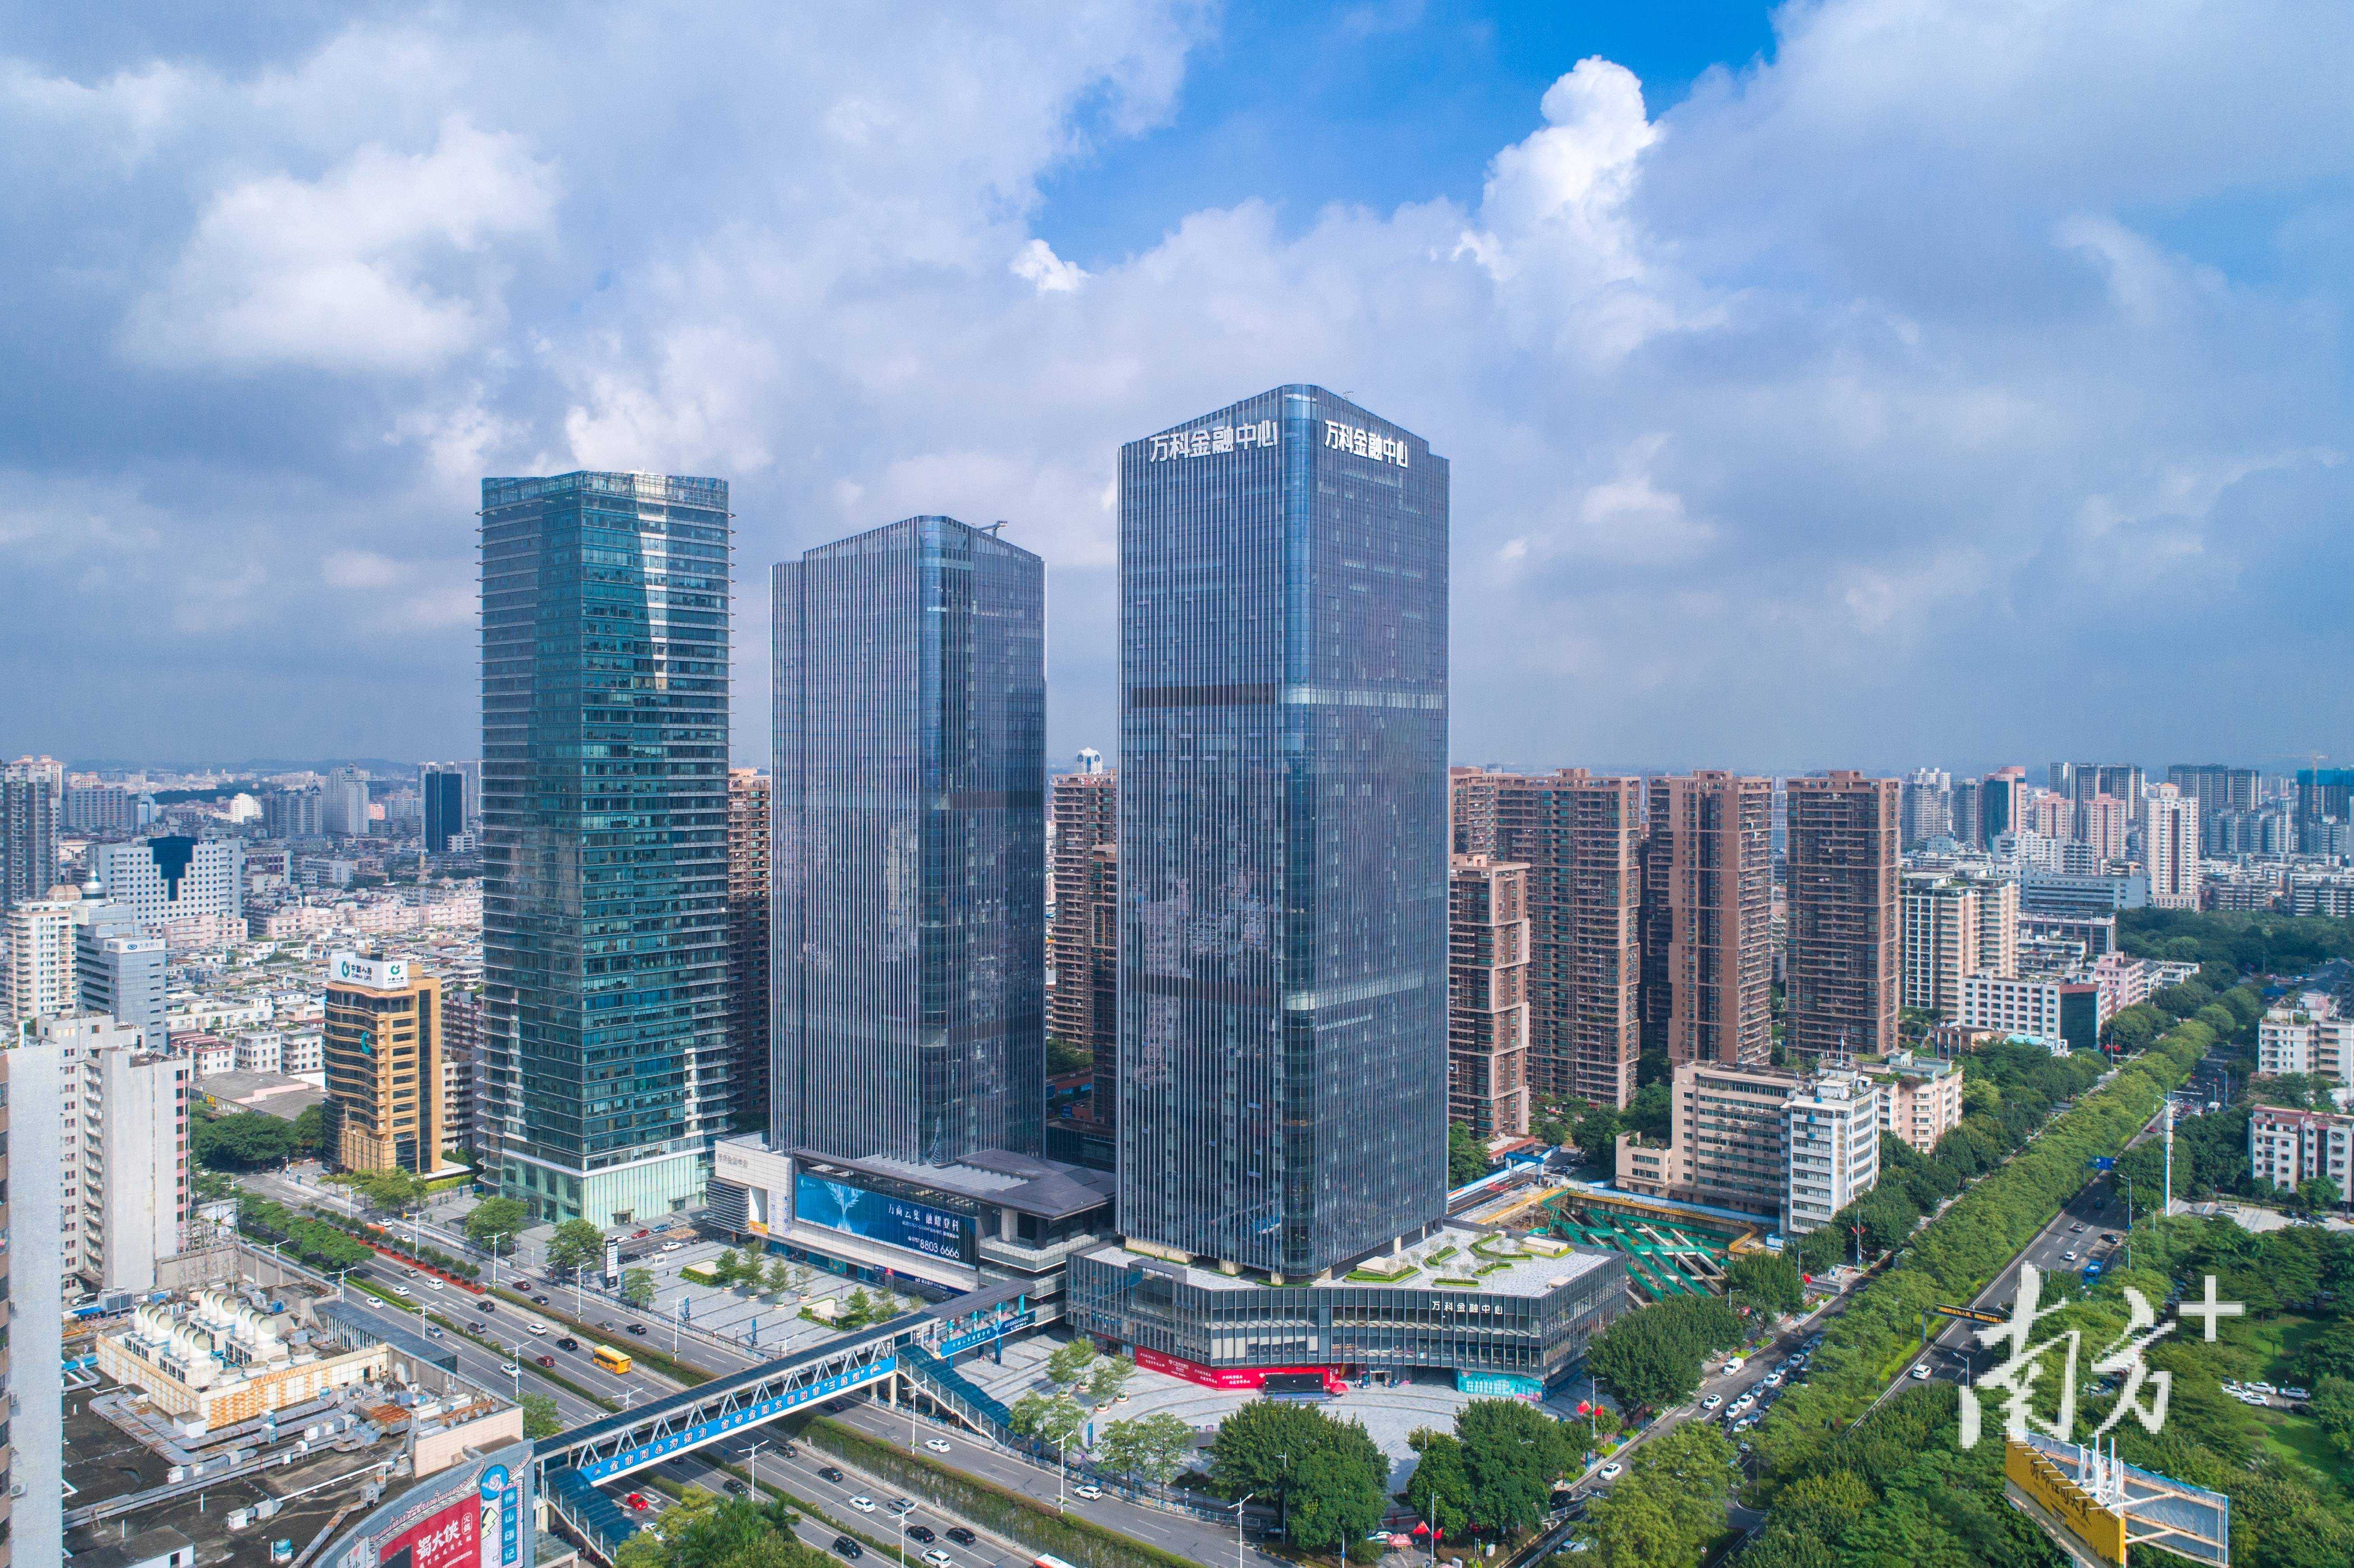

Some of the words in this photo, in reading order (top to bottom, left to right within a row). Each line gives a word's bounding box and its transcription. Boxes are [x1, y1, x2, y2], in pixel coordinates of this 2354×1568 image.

[1150, 420, 1278, 463] 万科金融中心
[1325, 420, 1408, 468] 万科金融中心
[351, 964, 372, 975] 中国人寿
[888, 1203, 920, 1221] 万商云集
[920, 1239, 938, 1253] 8803
[940, 1244, 959, 1258] 6666
[1432, 1301, 1503, 1315] 万科金融中心
[609, 1427, 706, 1472] 全市同心齐努力
[463, 1515, 471, 1532] 火锅
[504, 1491, 515, 1560] 佛山印记
[416, 1520, 461, 1560] 蜀大侠
